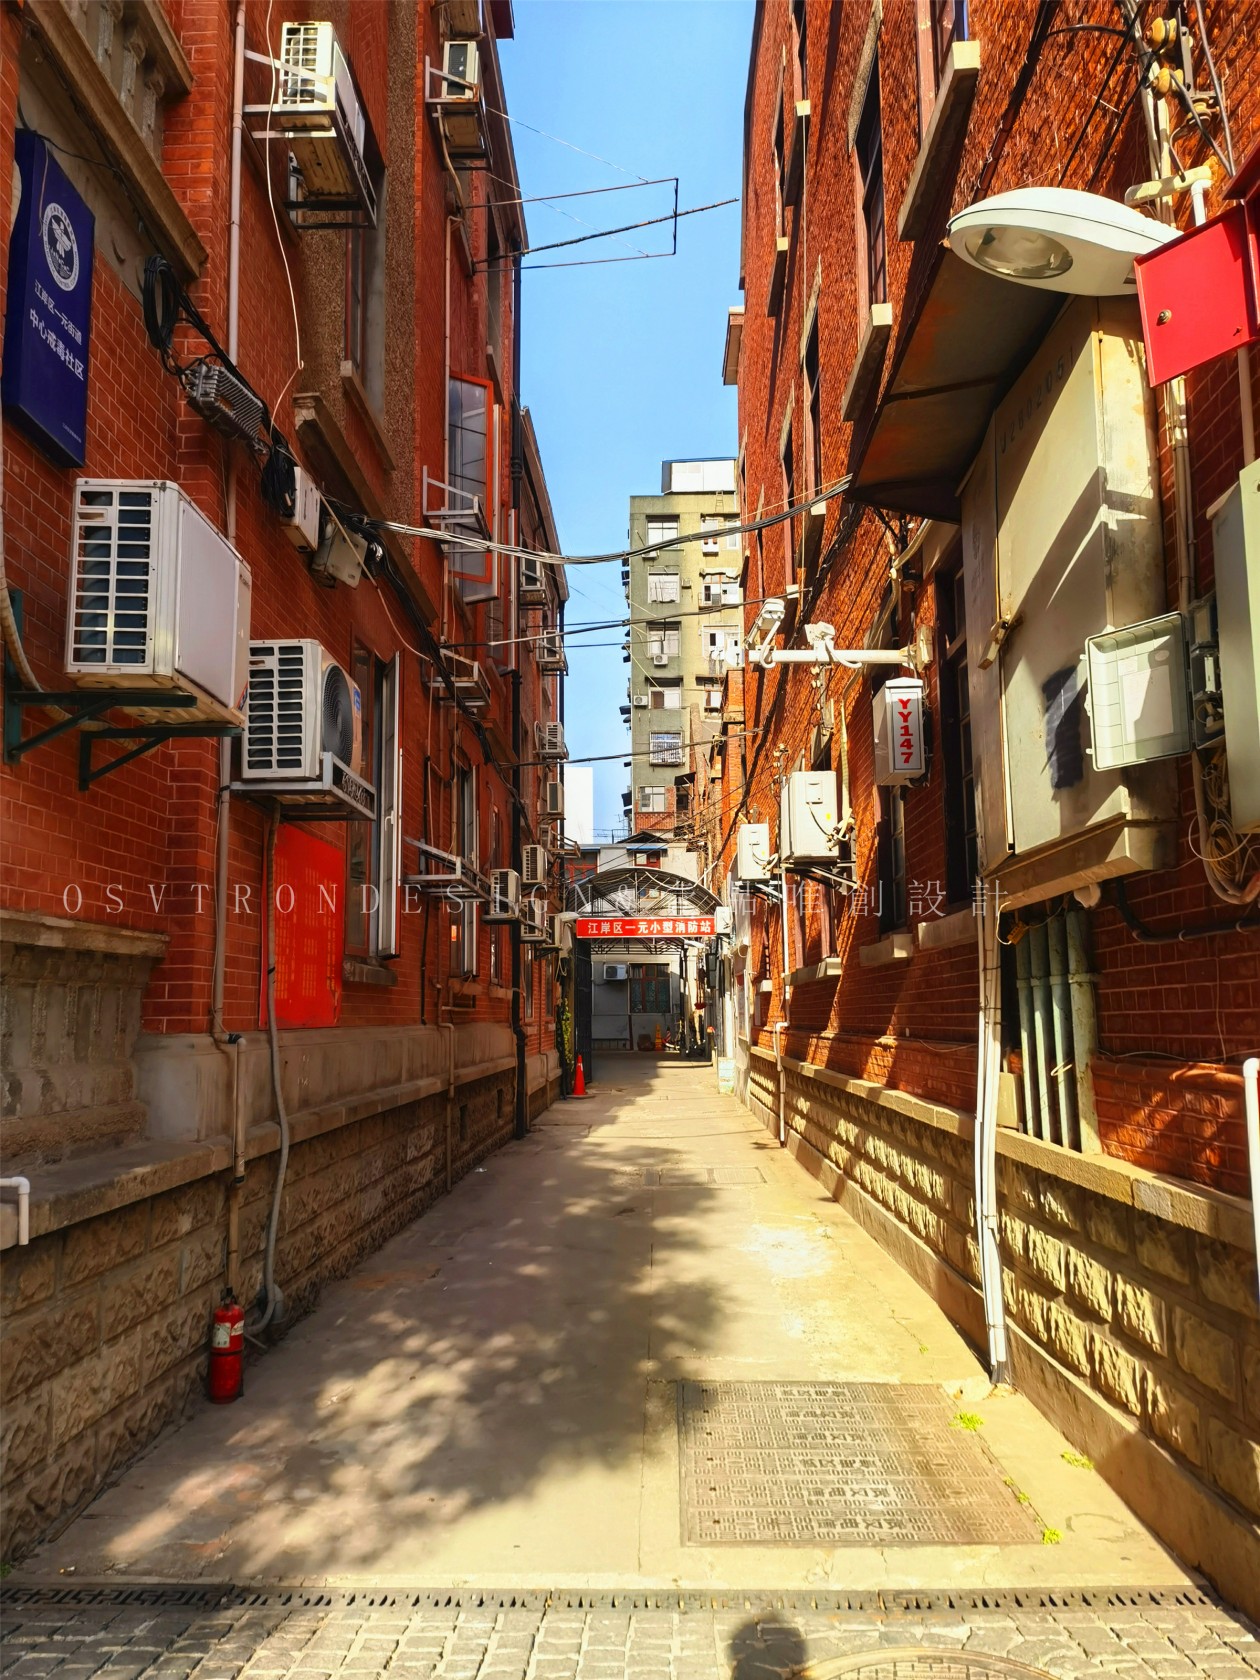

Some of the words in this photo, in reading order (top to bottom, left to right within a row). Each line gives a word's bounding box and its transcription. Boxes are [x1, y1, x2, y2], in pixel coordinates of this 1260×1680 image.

[30, 308, 84, 382] 中心戒毒社区
[34, 279, 83, 346] 江岸区一元街道
[898, 698, 914, 764] YY147
[588, 921, 711, 935] 江岸区一元小型消防站
